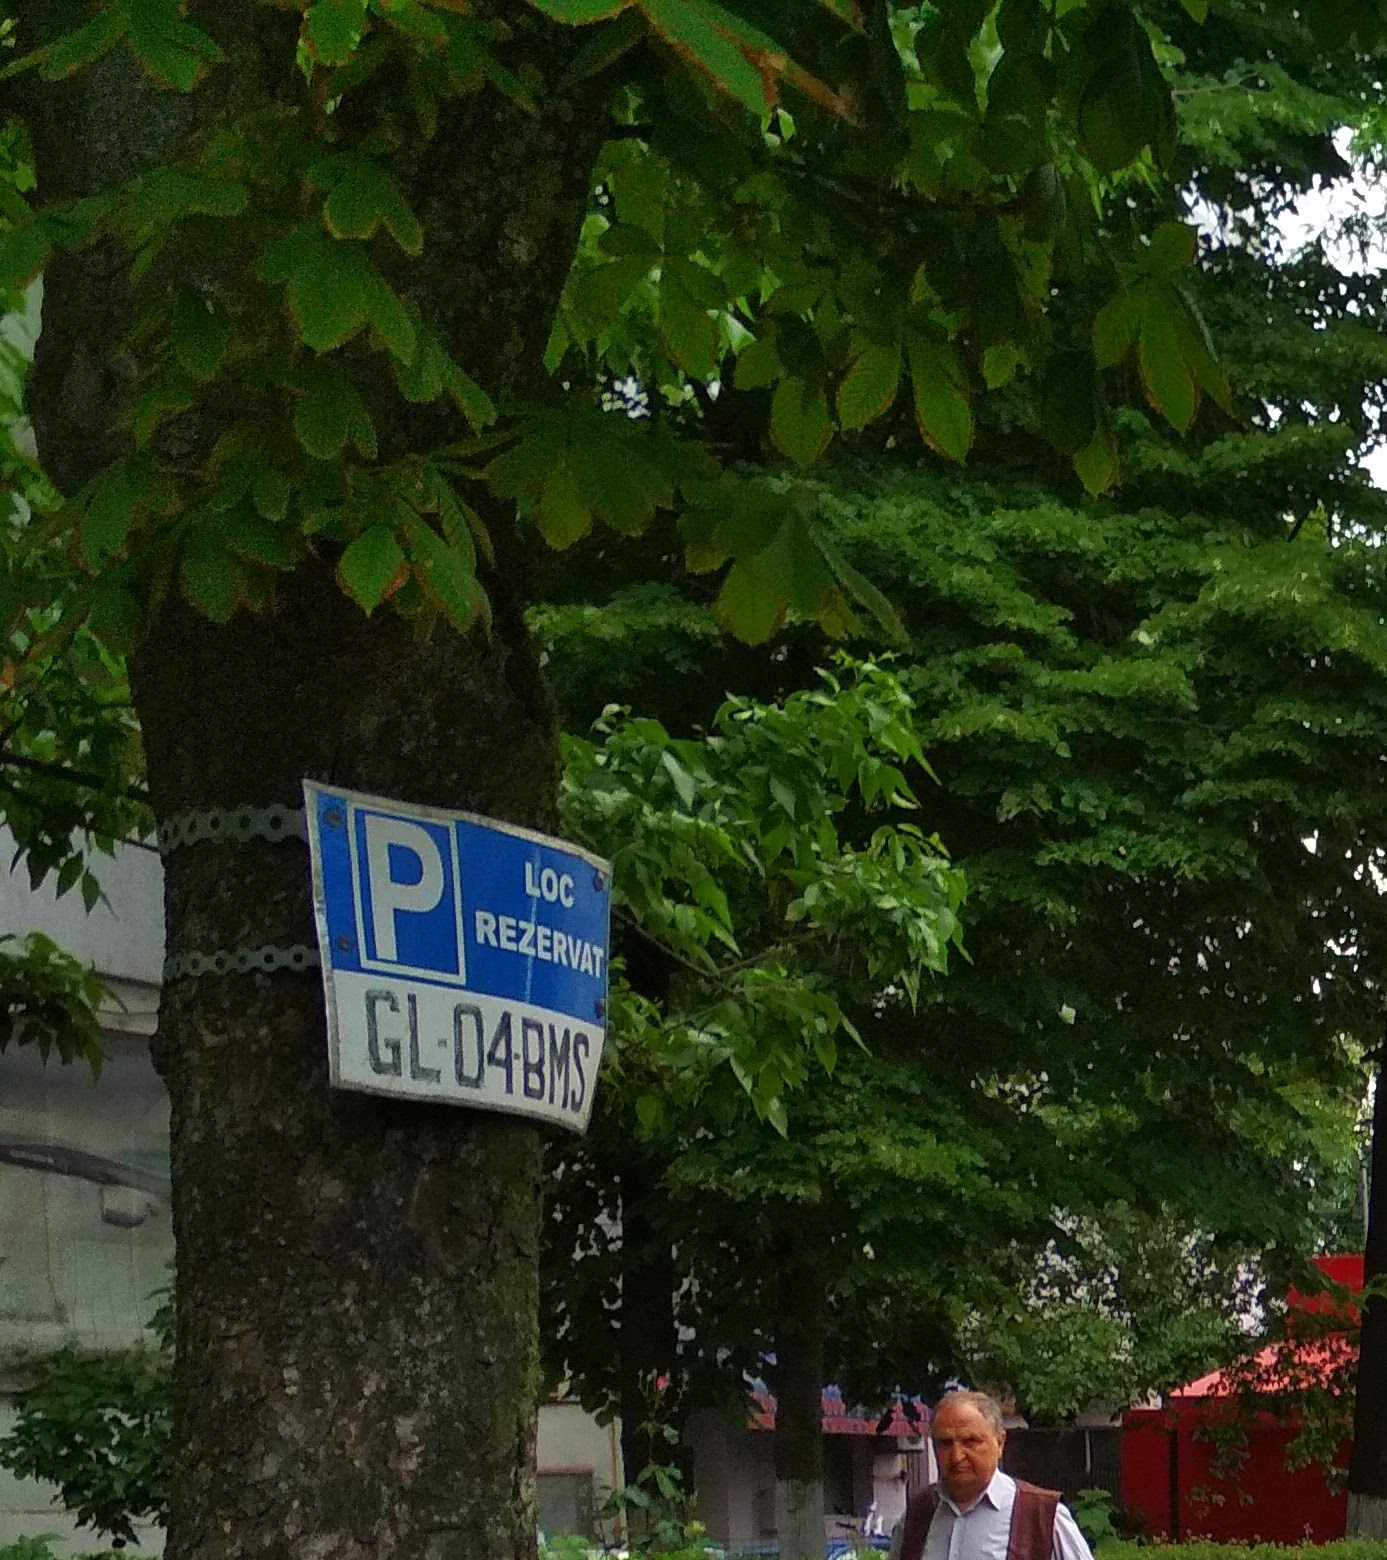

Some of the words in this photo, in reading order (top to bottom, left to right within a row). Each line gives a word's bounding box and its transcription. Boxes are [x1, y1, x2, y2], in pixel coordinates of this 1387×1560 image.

[365, 814, 445, 962] P
[524, 861, 575, 909] LOC
[474, 910, 604, 979] REZERVAT
